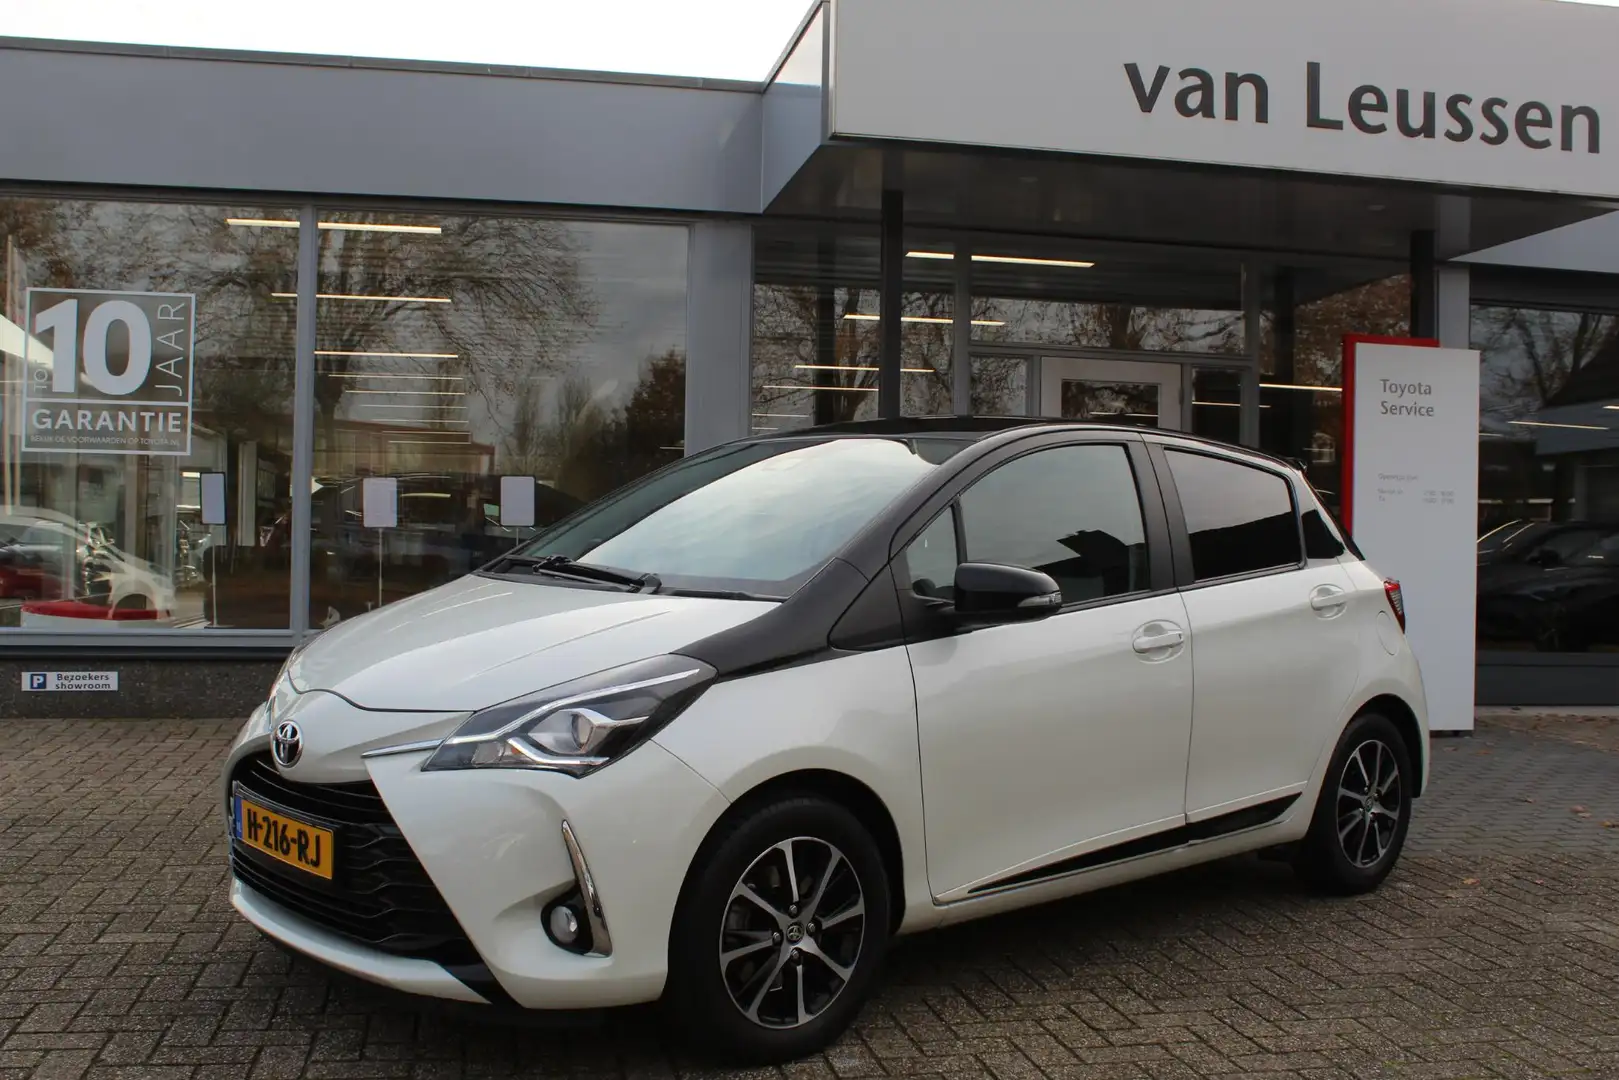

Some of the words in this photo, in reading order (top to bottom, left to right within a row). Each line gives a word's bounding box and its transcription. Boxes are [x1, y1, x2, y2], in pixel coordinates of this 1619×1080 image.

[1123, 62, 1269, 124] van
[1306, 61, 1601, 154] Leussen
[35, 298, 152, 396] 10
[155, 302, 185, 397] JAAR
[1380, 379, 1432, 398] Toyota
[1380, 400, 1435, 417] Service
[32, 408, 182, 433] GARANTIE
[32, 675, 44, 688] P
[55, 681, 111, 690] showroom
[56, 673, 110, 682] Bezoekers
[247, 808, 320, 868] H-216-RJ
